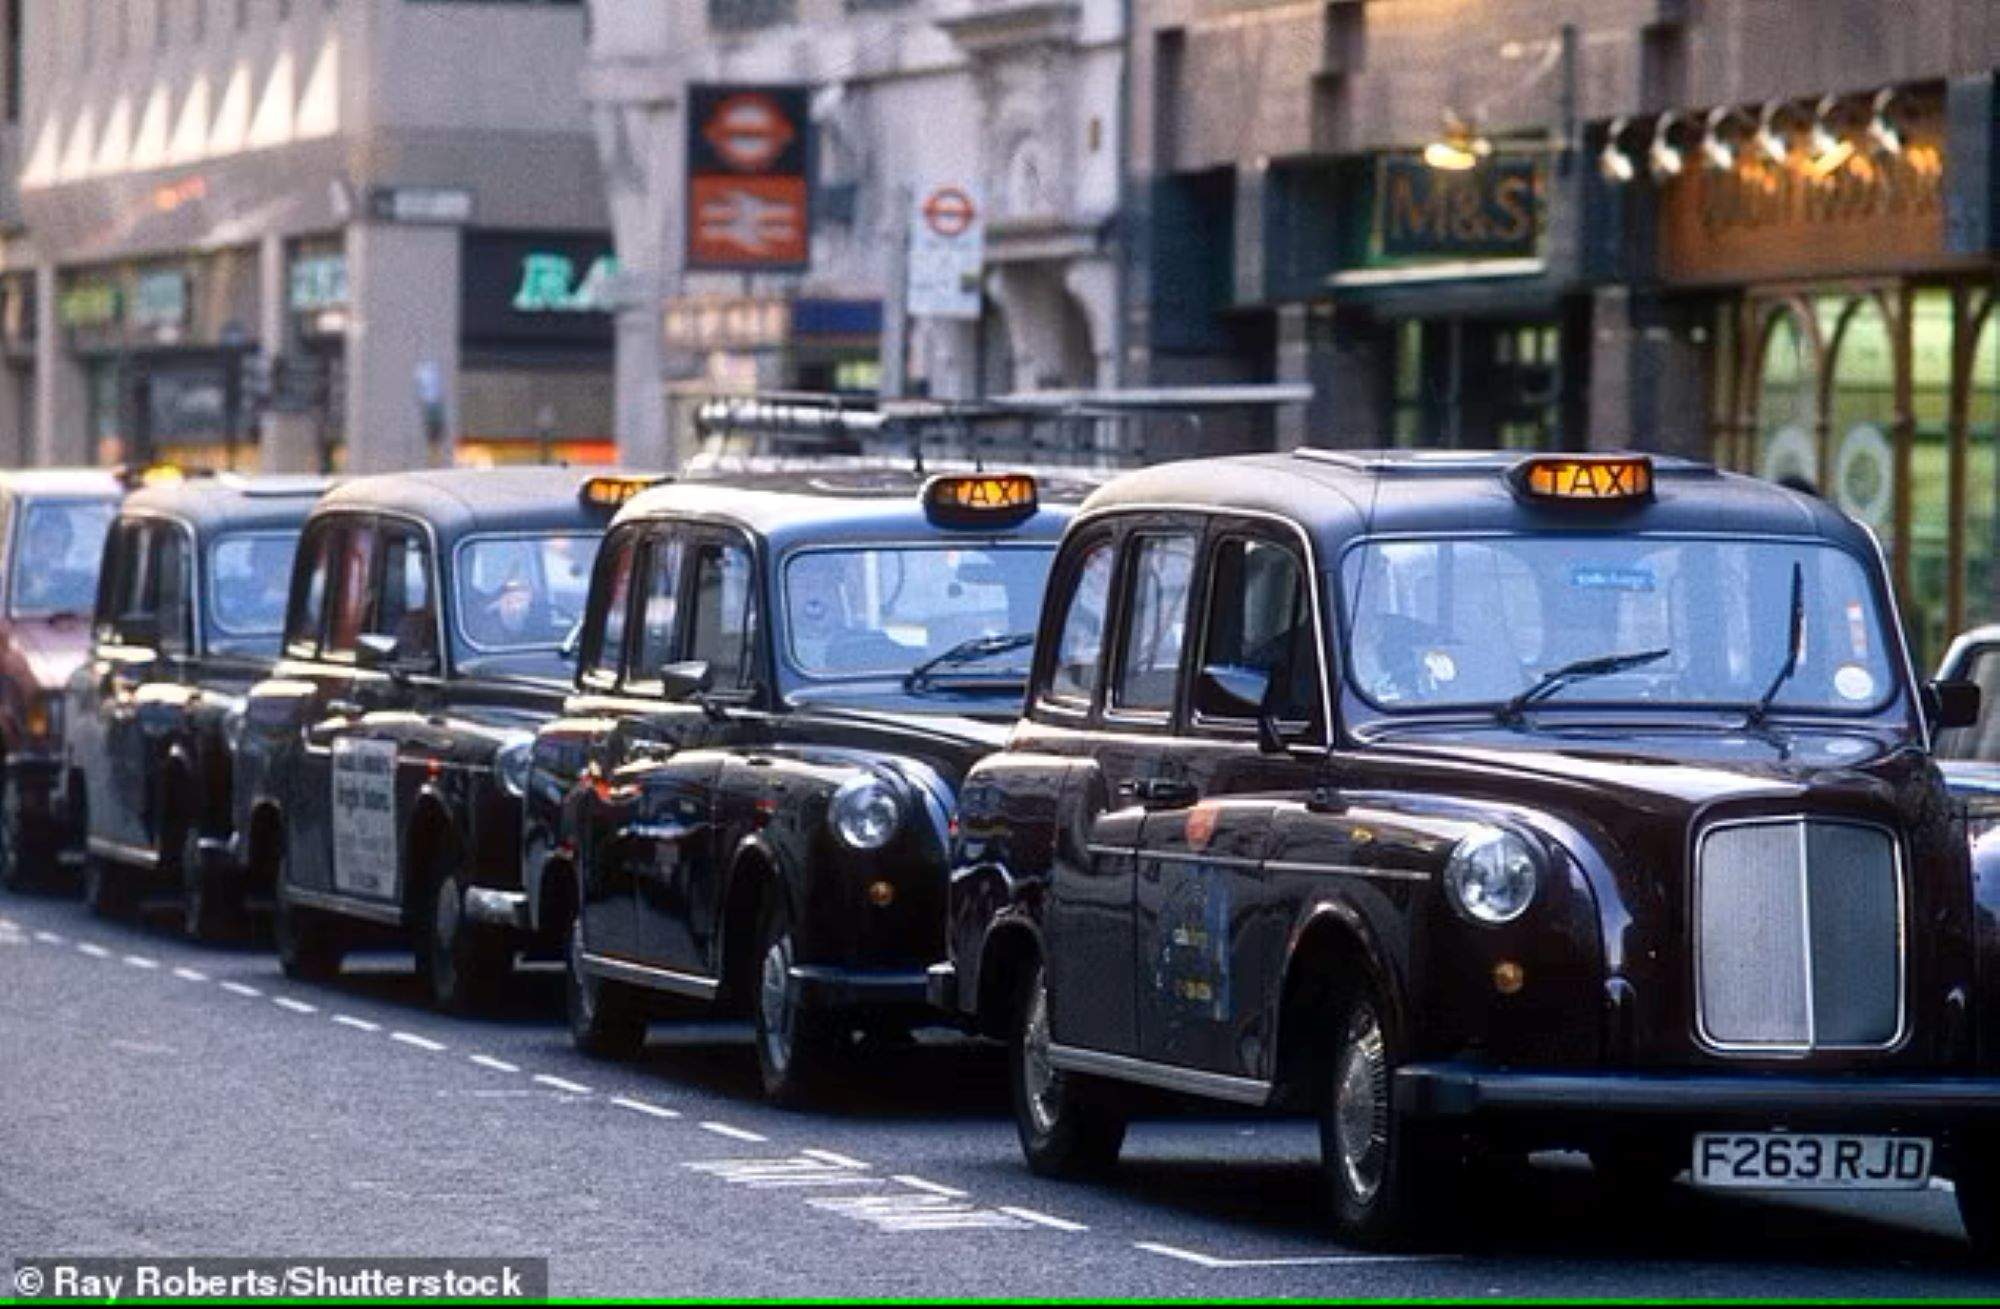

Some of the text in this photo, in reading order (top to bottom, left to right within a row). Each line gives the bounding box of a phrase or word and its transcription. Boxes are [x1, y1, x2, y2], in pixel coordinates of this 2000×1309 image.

[946, 478, 1026, 505] TAXI
[1540, 463, 1637, 497] TAXI
[1703, 1137, 1924, 1179] F263 RJD
